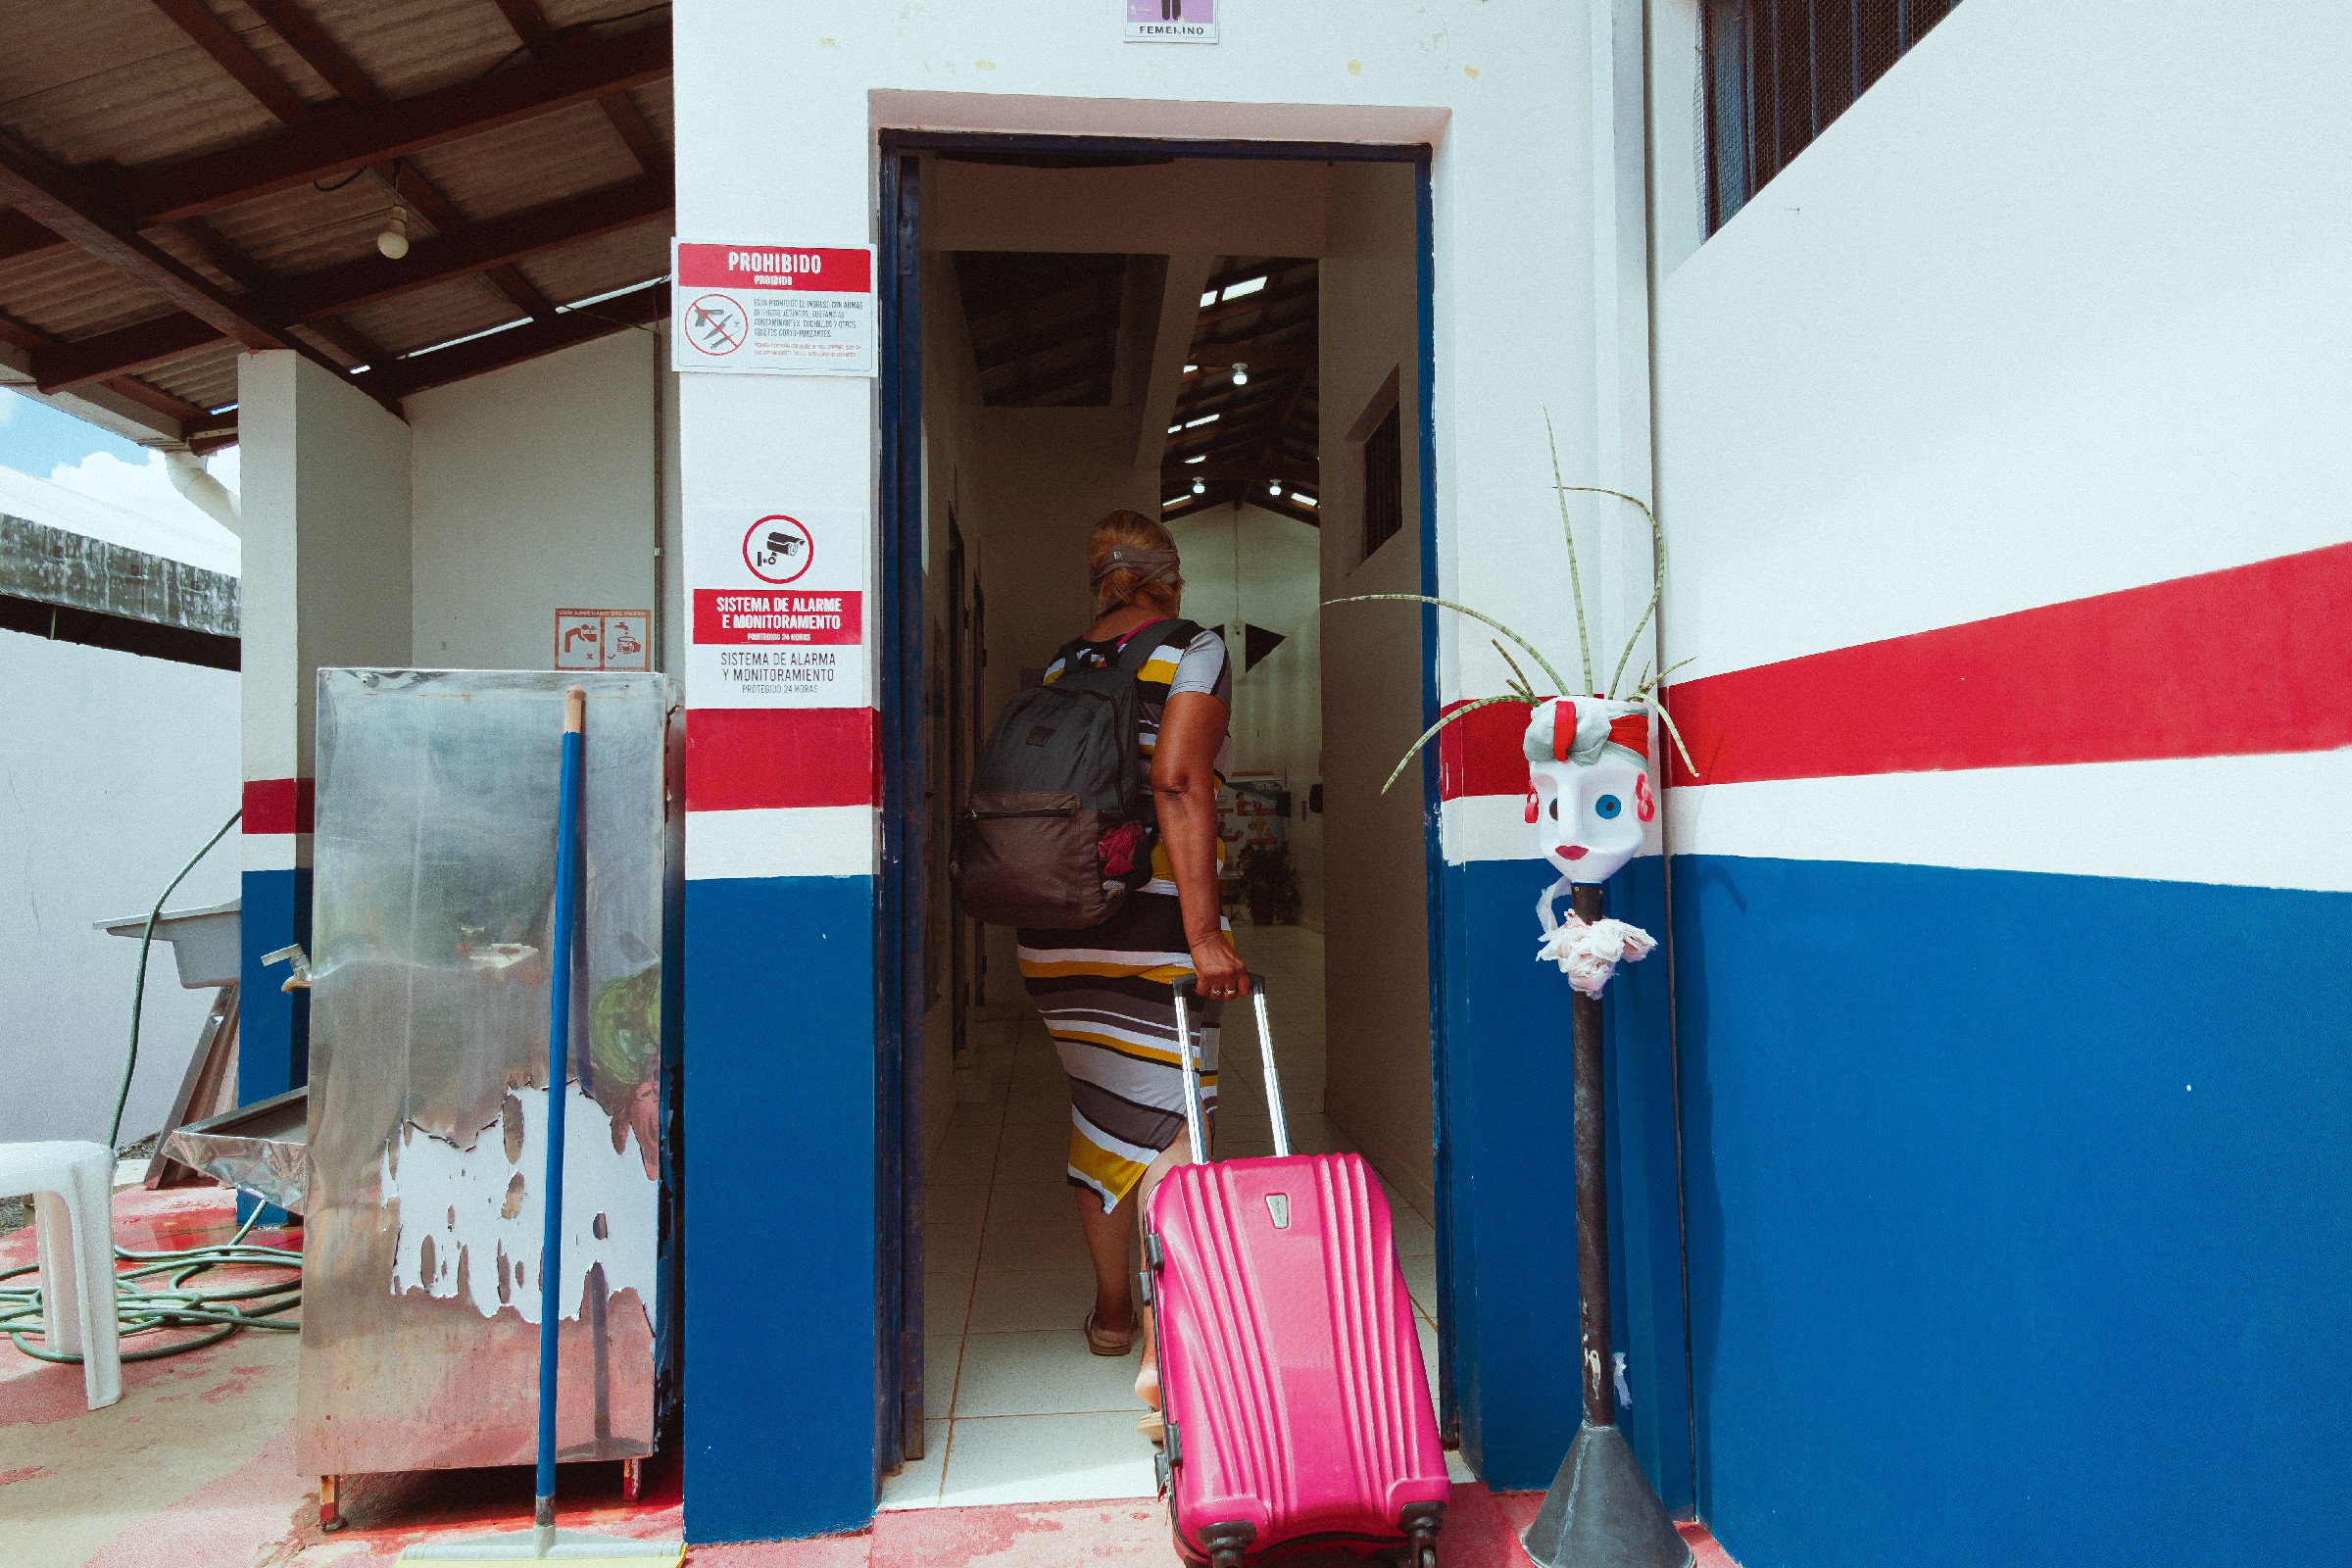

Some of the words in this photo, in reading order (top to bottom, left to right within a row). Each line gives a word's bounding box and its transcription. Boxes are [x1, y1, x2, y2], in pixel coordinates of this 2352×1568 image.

[728, 252, 821, 274] PROHIBIDO
[843, 301, 863, 310] ARMAS
[716, 596, 770, 612] SISTEMA
[773, 597, 789, 612] DE
[792, 597, 843, 612] ALARME
[722, 614, 730, 629] E
[733, 614, 841, 630] MONITORAMENTO
[720, 652, 769, 665] SISTEMA
[773, 653, 786, 665] DE
[790, 653, 836, 665] ALARMA
[722, 668, 730, 682] Y
[733, 668, 834, 682] MONITORAMIENTO
[742, 684, 782, 693] PROTEGIDO
[783, 684, 793, 694] 24
[795, 685, 818, 694] HORAS
